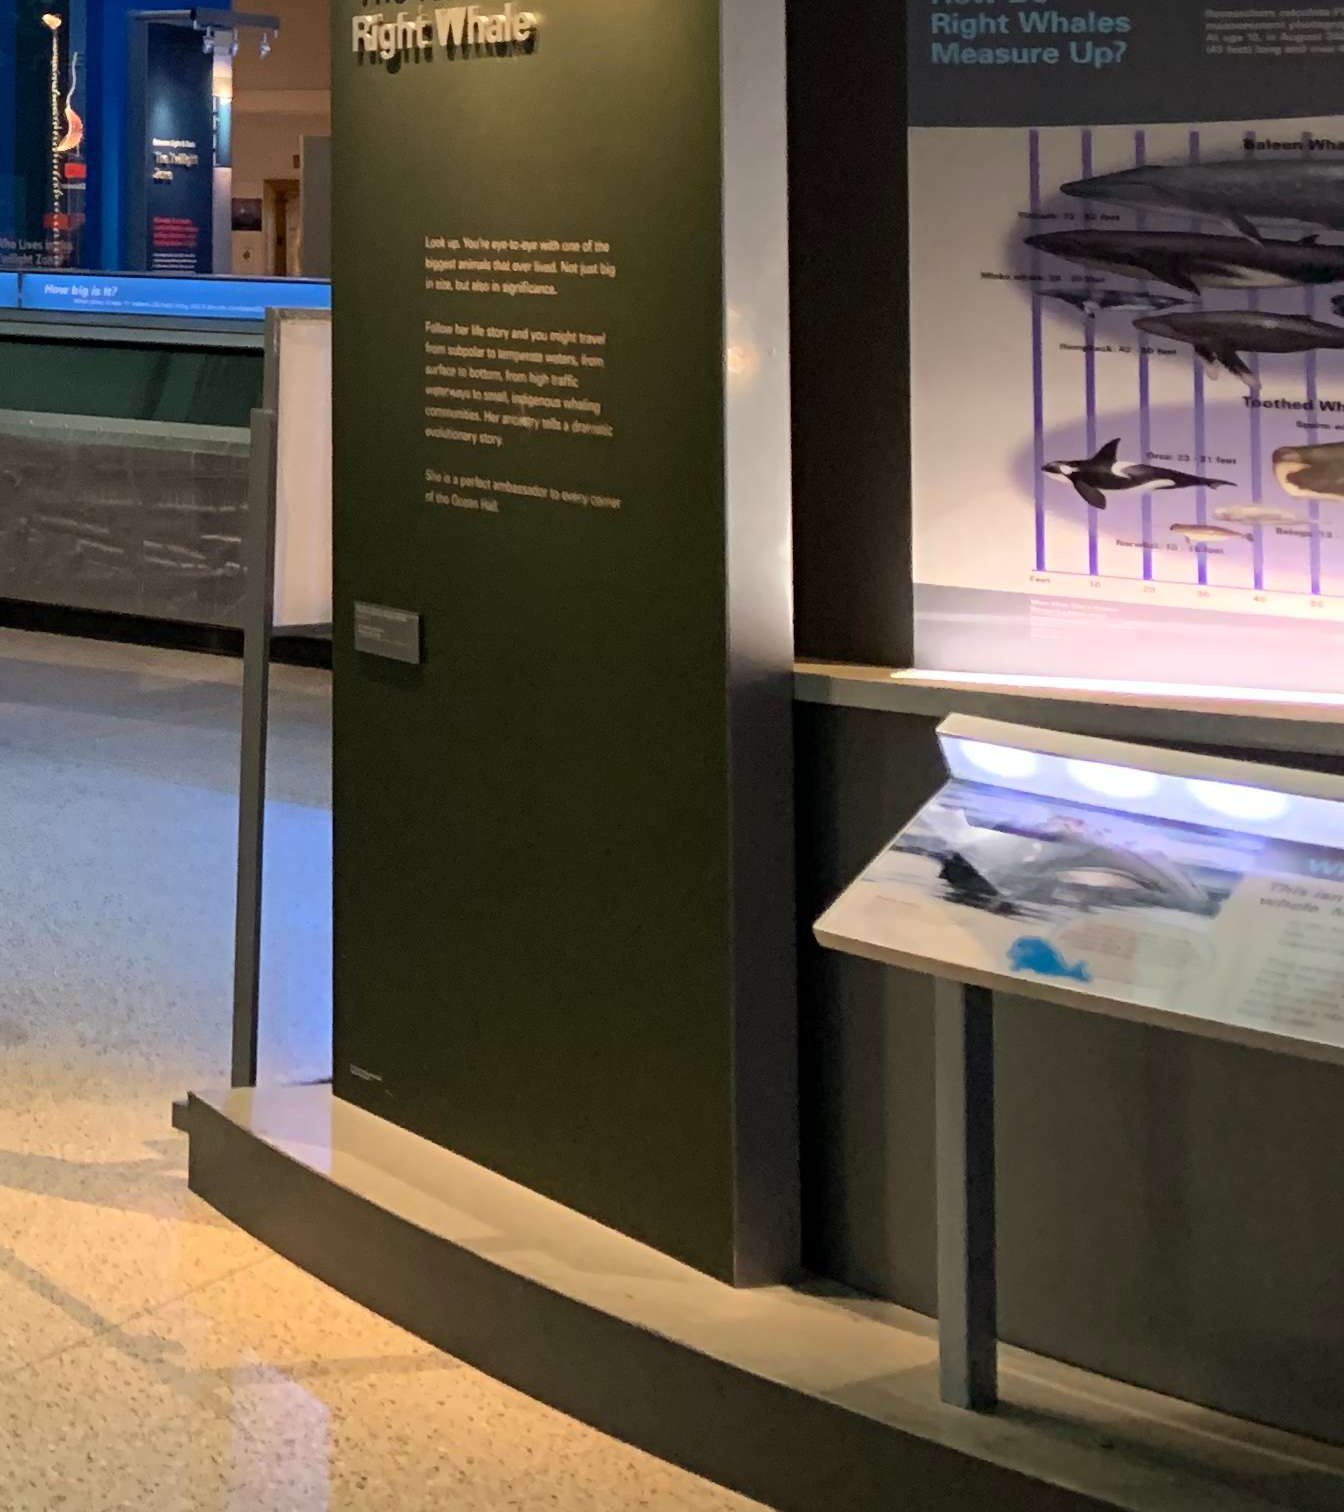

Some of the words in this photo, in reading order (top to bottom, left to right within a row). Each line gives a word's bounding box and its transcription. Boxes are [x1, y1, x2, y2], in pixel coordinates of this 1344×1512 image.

[351, 7, 433, 60] Right
[434, 2, 537, 46] Whale
[931, 12, 1010, 39] Right
[1018, 10, 1132, 33] Whales
[931, 41, 1060, 64] Measure
[1069, 39, 1128, 69] Up?
[1242, 137, 1303, 150] Baleen
[44, 284, 68, 295] How
[1242, 396, 1315, 410] Toothed
